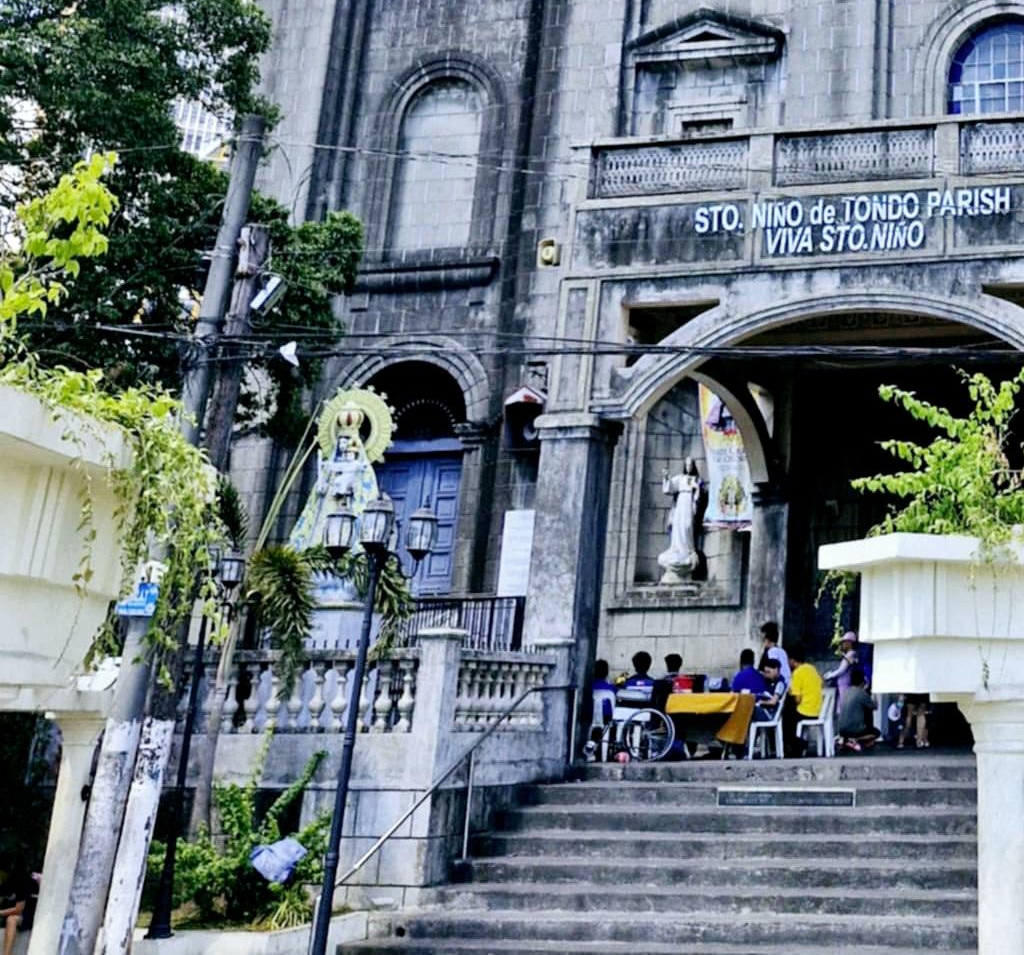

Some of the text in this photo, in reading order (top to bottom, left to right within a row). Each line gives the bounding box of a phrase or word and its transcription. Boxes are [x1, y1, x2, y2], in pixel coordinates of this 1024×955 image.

[694, 187, 1011, 233] STO. NIÑO de TONDO PARISH
[766, 226, 813, 255] VIVA
